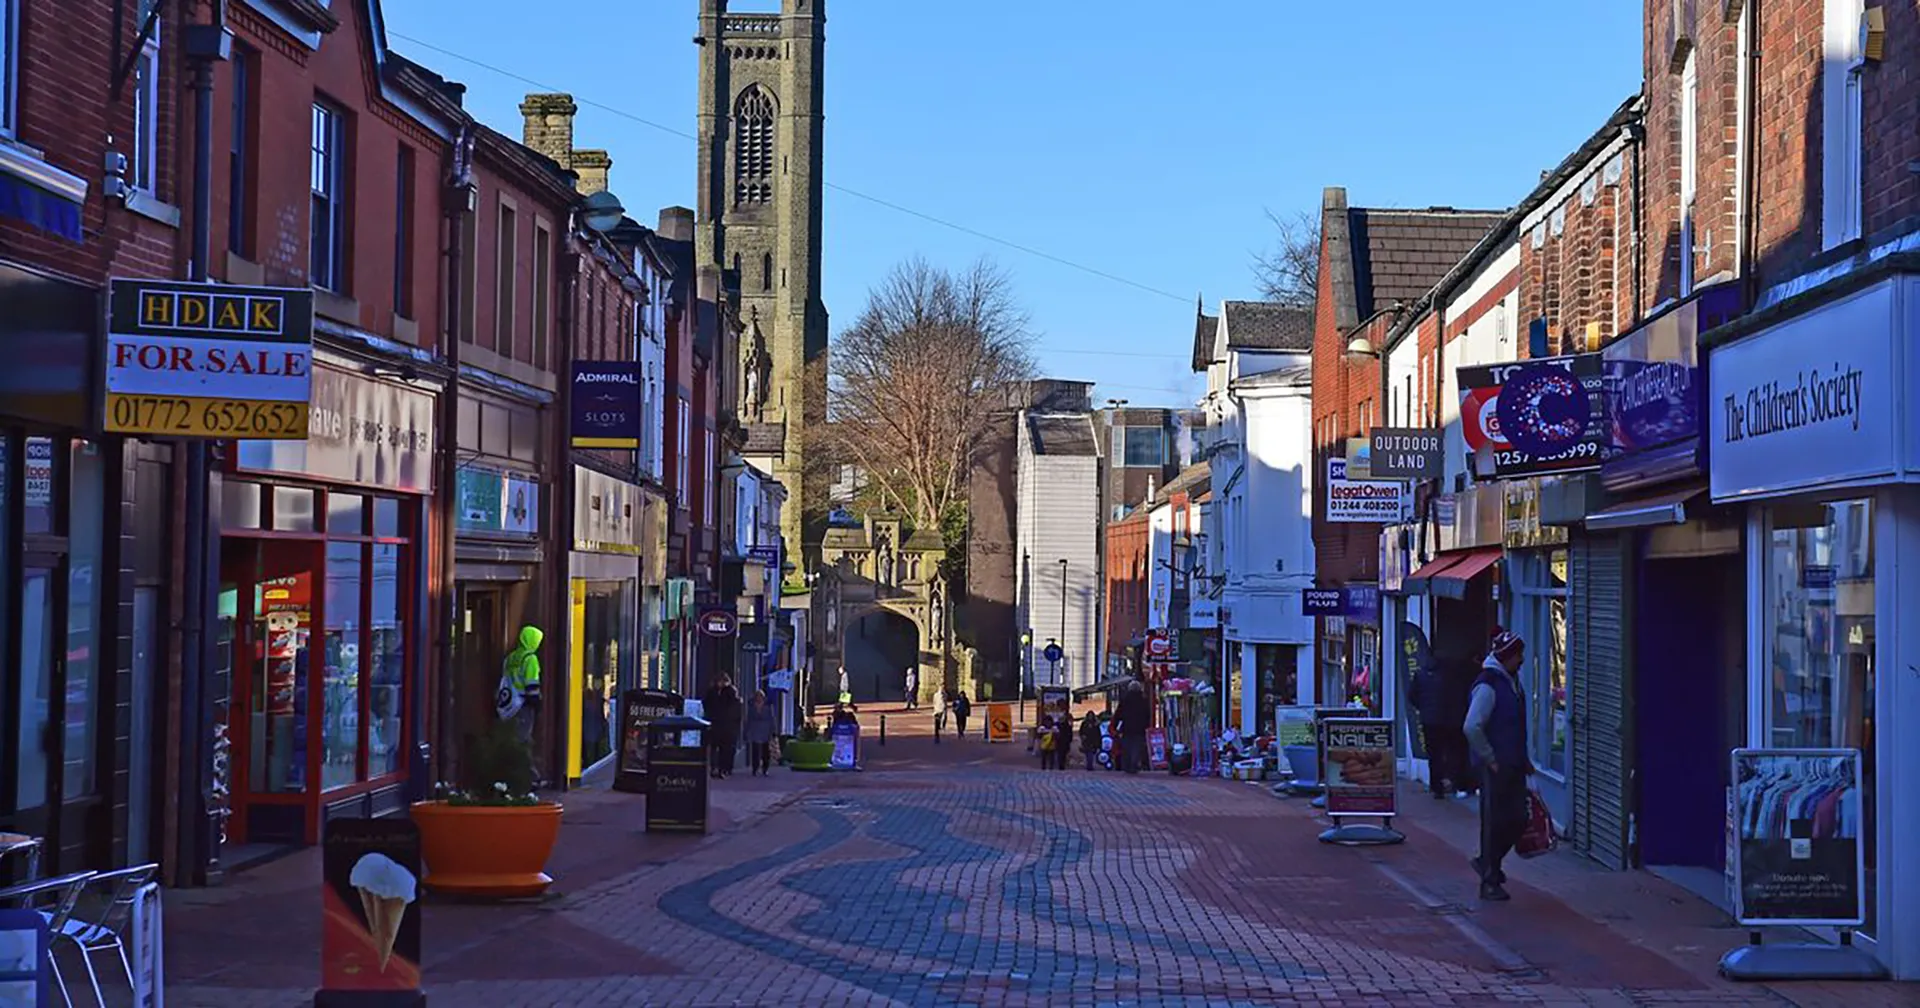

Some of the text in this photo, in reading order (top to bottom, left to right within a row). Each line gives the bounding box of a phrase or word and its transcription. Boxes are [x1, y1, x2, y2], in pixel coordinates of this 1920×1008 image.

[146, 295, 277, 329] HDAK
[115, 343, 306, 377] FOR SALE
[575, 371, 638, 385] ADMIRAL
[1724, 360, 1864, 444] The Children's Society
[114, 396, 299, 434] 01772 652652
[585, 411, 626, 424] SLOTS
[1375, 435, 1439, 451] OUTDOOR
[1388, 454, 1425, 469] LAND
[1330, 501, 1399, 511] 01244 408200
[1306, 591, 1340, 599] POUND
[1307, 599, 1338, 607] PLUS
[1329, 724, 1388, 733] PERFECT
[1329, 734, 1389, 747] NAILS
